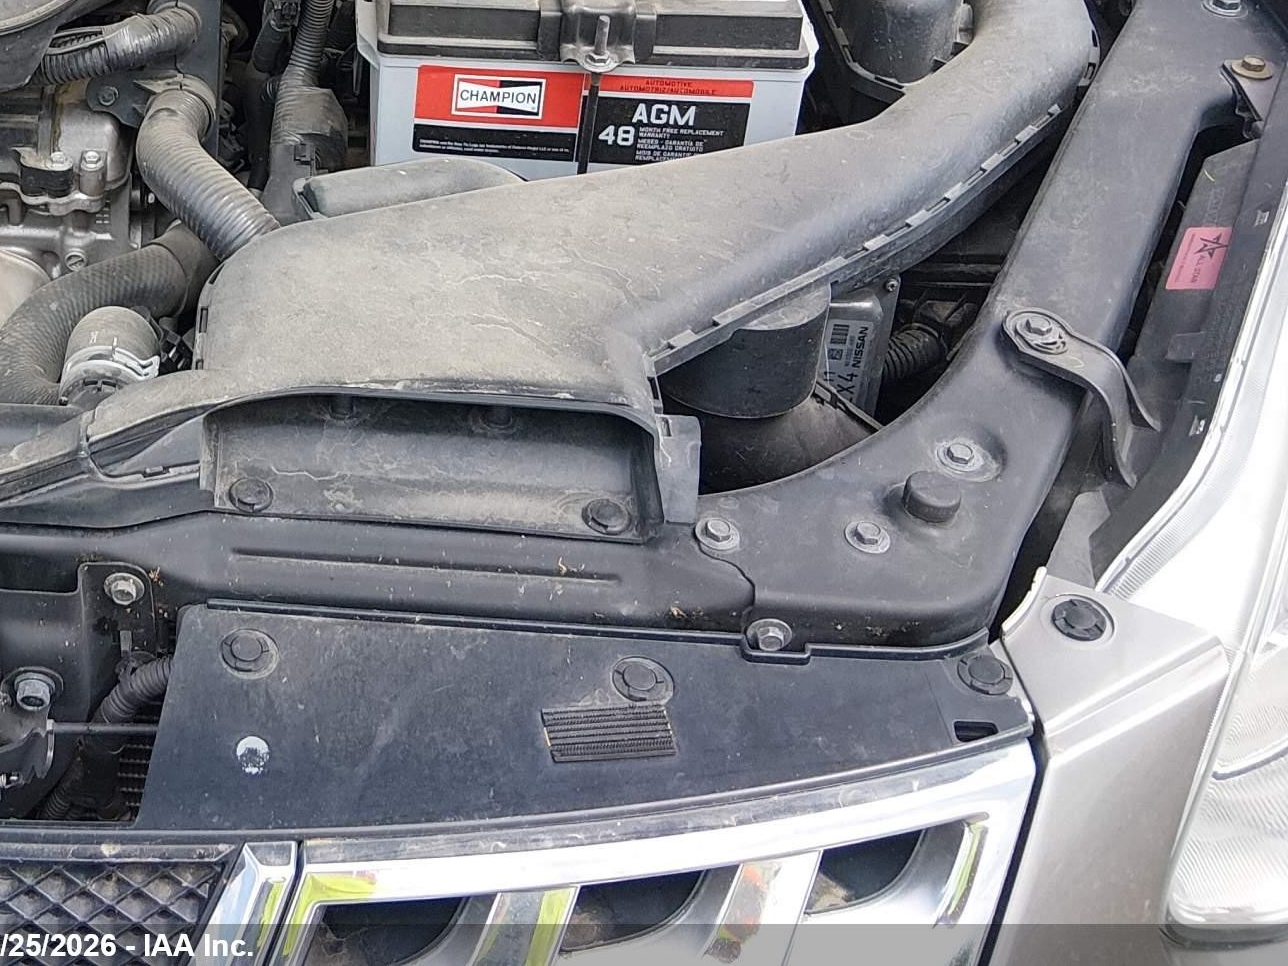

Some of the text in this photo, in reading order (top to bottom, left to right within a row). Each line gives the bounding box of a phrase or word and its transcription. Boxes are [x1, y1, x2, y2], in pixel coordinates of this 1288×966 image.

[644, 79, 693, 88] AUTOMOTIVE
[460, 89, 537, 105] CHAMPION
[631, 103, 697, 127] AGM
[598, 125, 636, 147] 48
[662, 127, 679, 135] FREE
[679, 128, 725, 137] REPLACEMENT
[695, 140, 704, 148] DE
[852, 326, 869, 369] NISSAN
